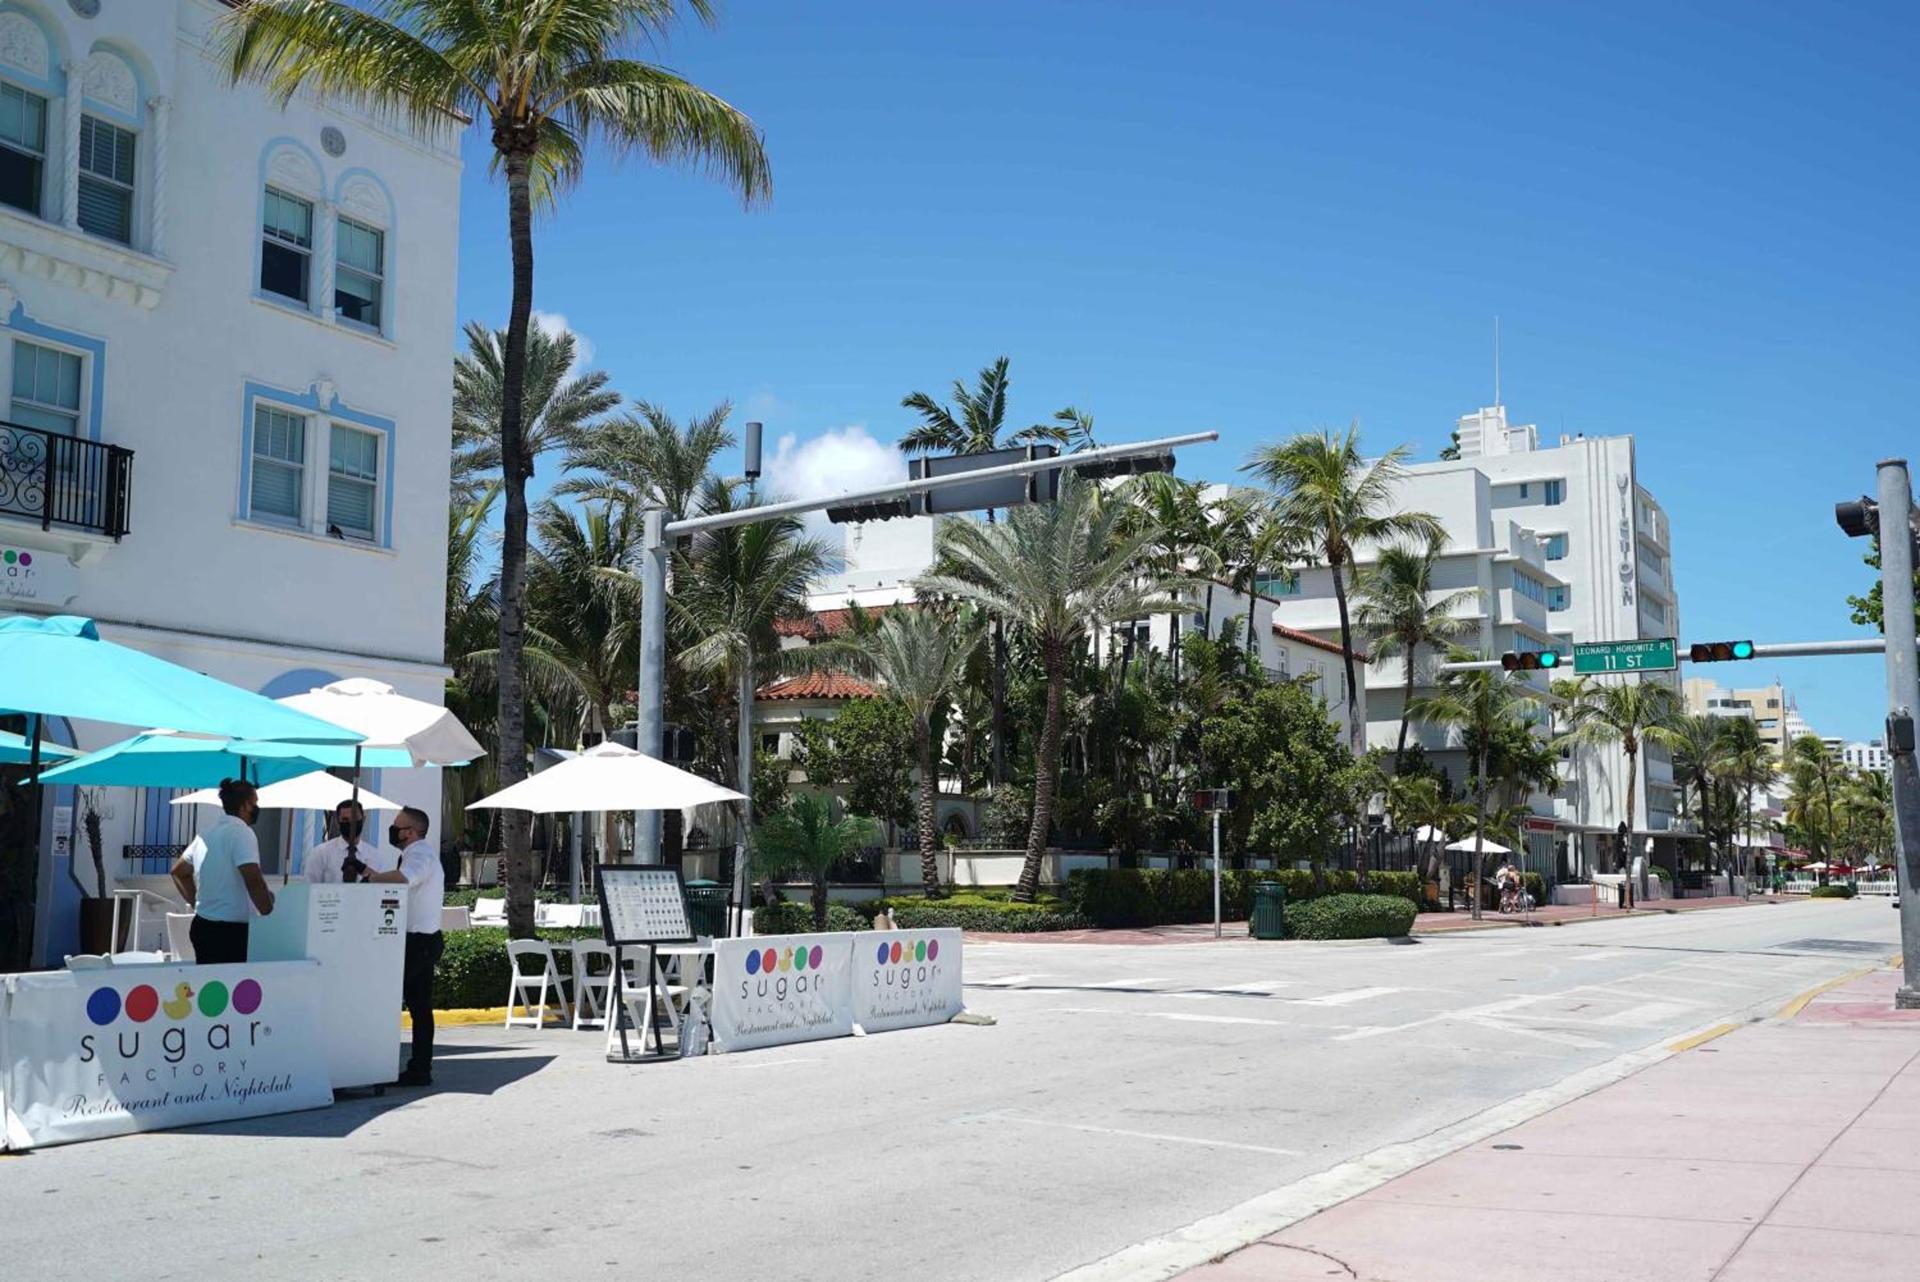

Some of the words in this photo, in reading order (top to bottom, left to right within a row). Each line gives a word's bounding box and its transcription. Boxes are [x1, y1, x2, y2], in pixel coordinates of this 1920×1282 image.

[1576, 646, 1611, 656] LEONARD
[1616, 643, 1654, 653] HOROWITZ
[1659, 642, 1670, 651] PL
[1604, 655, 1616, 670] 11
[1626, 655, 1643, 668] ST
[741, 974, 820, 1001] sugar
[874, 964, 937, 989] sugar
[80, 1021, 260, 1063] sugar
[98, 1060, 247, 1086] FACTORY
[63, 1092, 169, 1118] Restaurant
[174, 1083, 207, 1104] and
[212, 1074, 292, 1104] Nightclub
